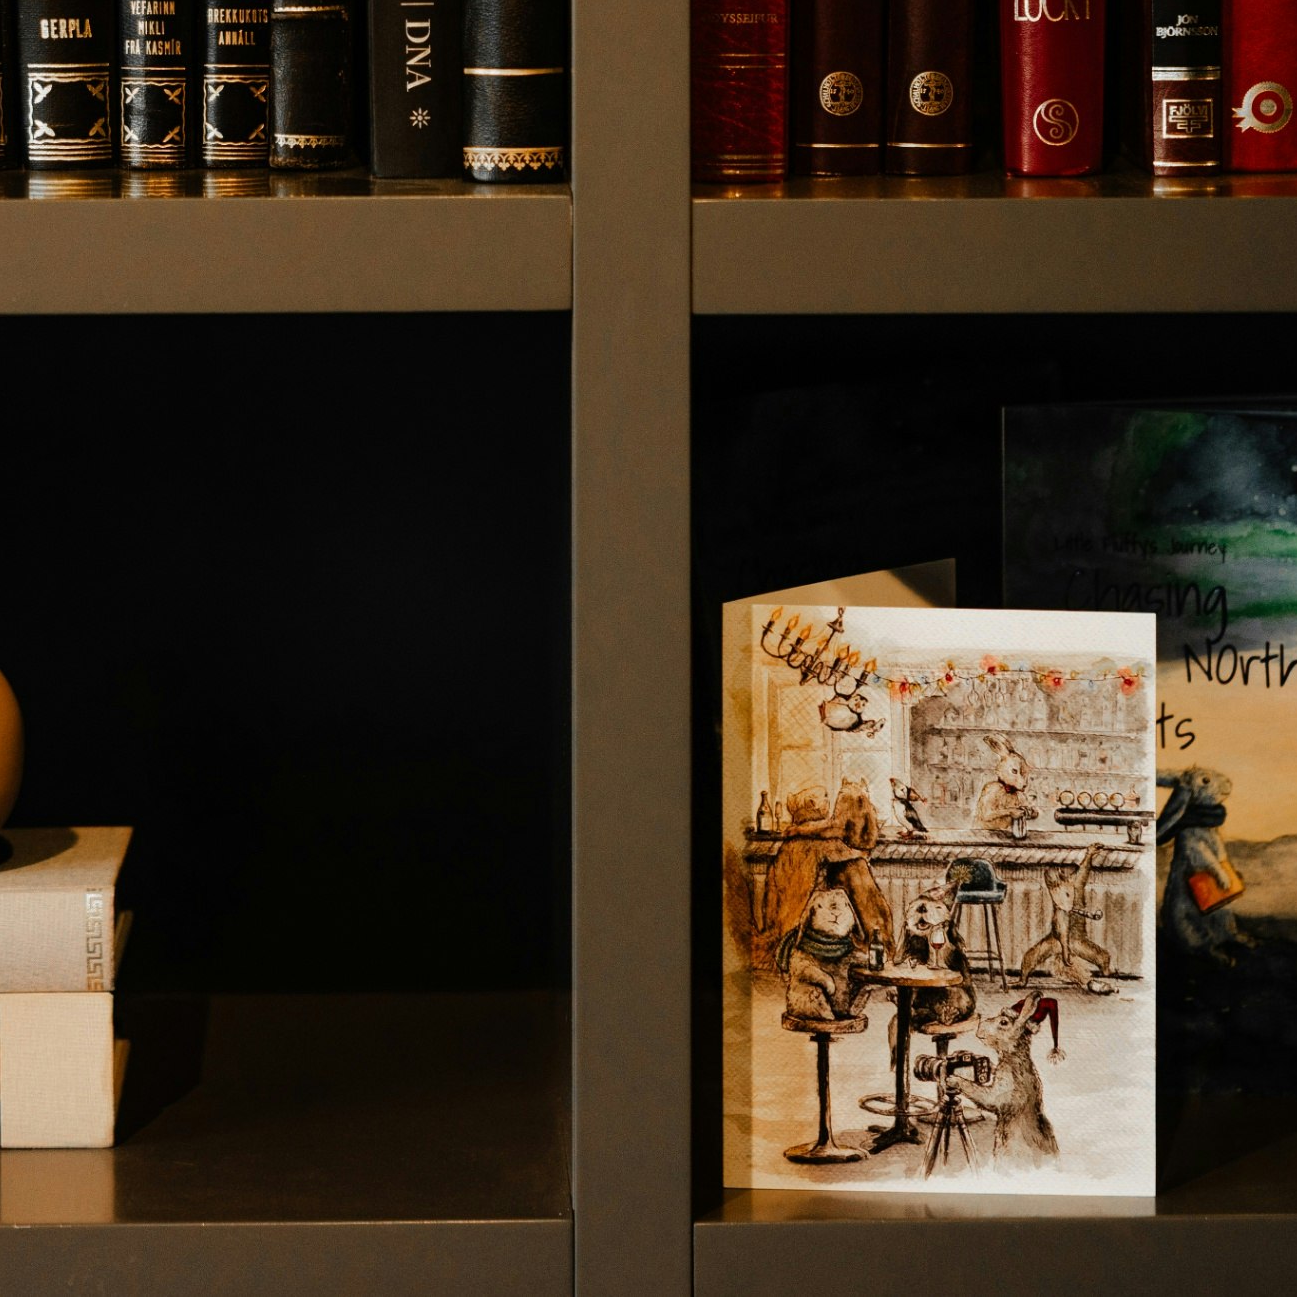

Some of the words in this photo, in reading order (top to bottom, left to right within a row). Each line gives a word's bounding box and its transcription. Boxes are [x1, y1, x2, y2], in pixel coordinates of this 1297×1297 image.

[130, 0, 176, 15] VEFARINN
[207, 7, 270, 24] BREKKUKOTS
[39, 17, 93, 40] GERPLA
[137, 20, 166, 36] MIKLI
[1176, 14, 1199, 25] JÓN
[125, 39, 141, 56] FRÁ
[145, 37, 182, 56] KASMÍR
[218, 29, 256, 47] ANNÁLL
[405, 18, 432, 92] DNA
[1064, 568, 1228, 644] Chasing
